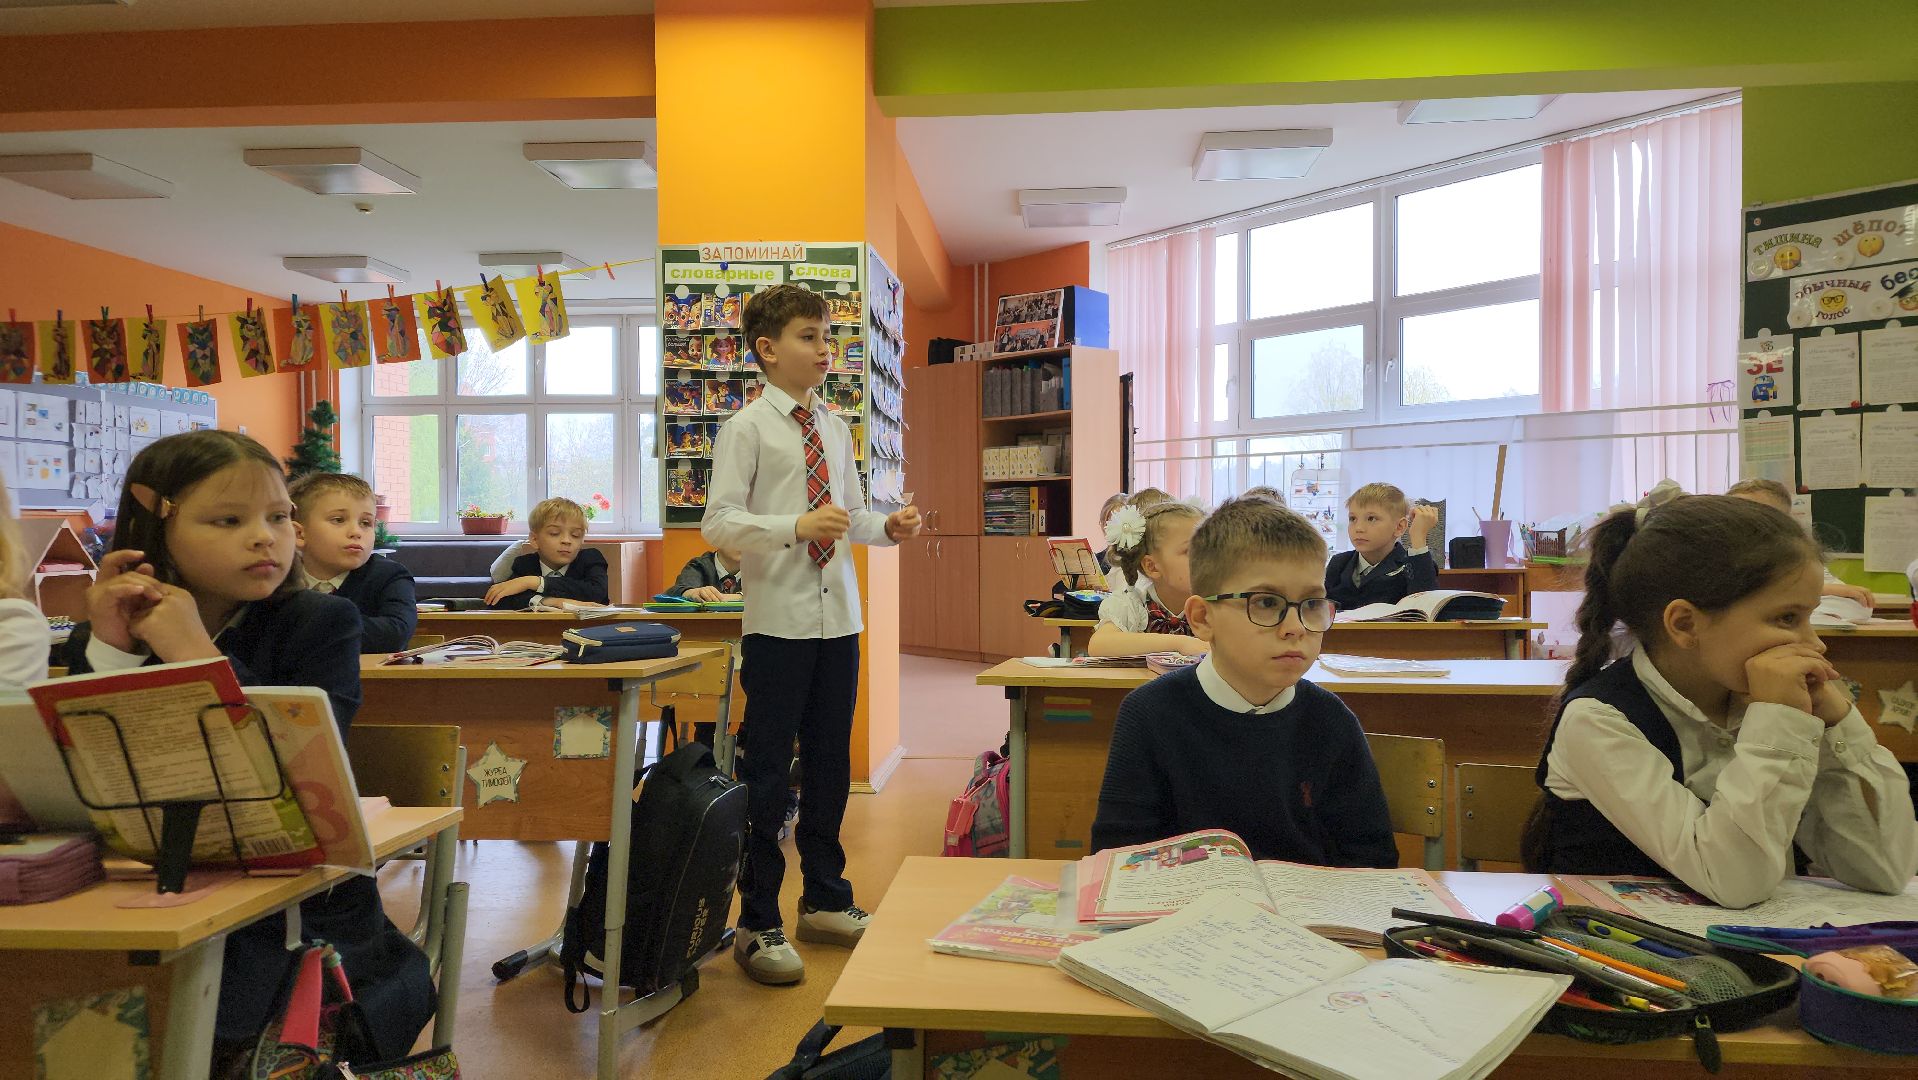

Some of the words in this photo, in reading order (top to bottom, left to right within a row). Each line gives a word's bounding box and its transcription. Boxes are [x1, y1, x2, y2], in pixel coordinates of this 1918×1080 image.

[701, 243, 804, 261] ЗАПОМИНАЙ
[1752, 232, 1824, 256] тишина
[670, 267, 775, 282] словарные
[795, 264, 852, 279] слова
[1795, 279, 1872, 299] обычный
[1815, 306, 1851, 321] голос
